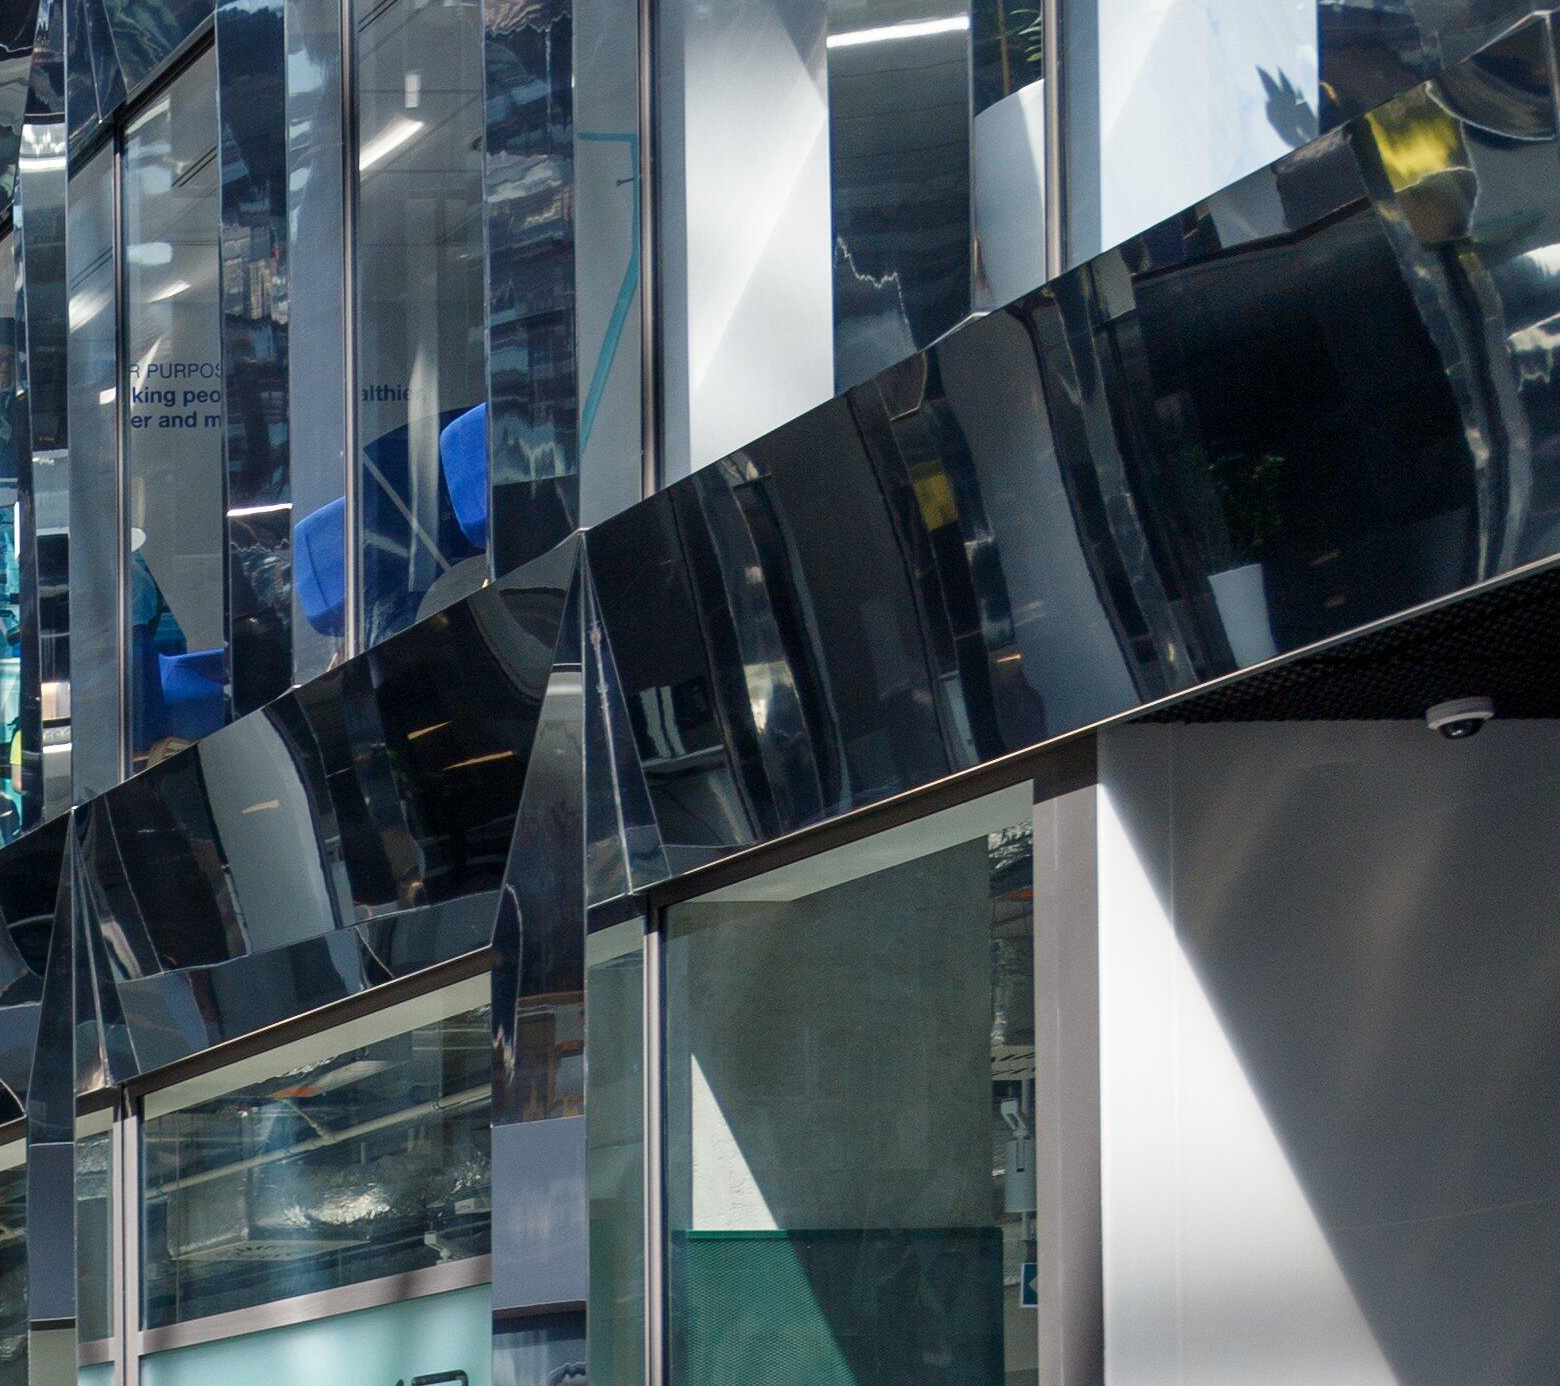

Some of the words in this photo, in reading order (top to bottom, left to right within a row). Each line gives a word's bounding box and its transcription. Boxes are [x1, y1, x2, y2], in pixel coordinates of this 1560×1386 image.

[131, 387, 176, 407] king
[130, 414, 152, 428] er
[158, 412, 198, 428] and
